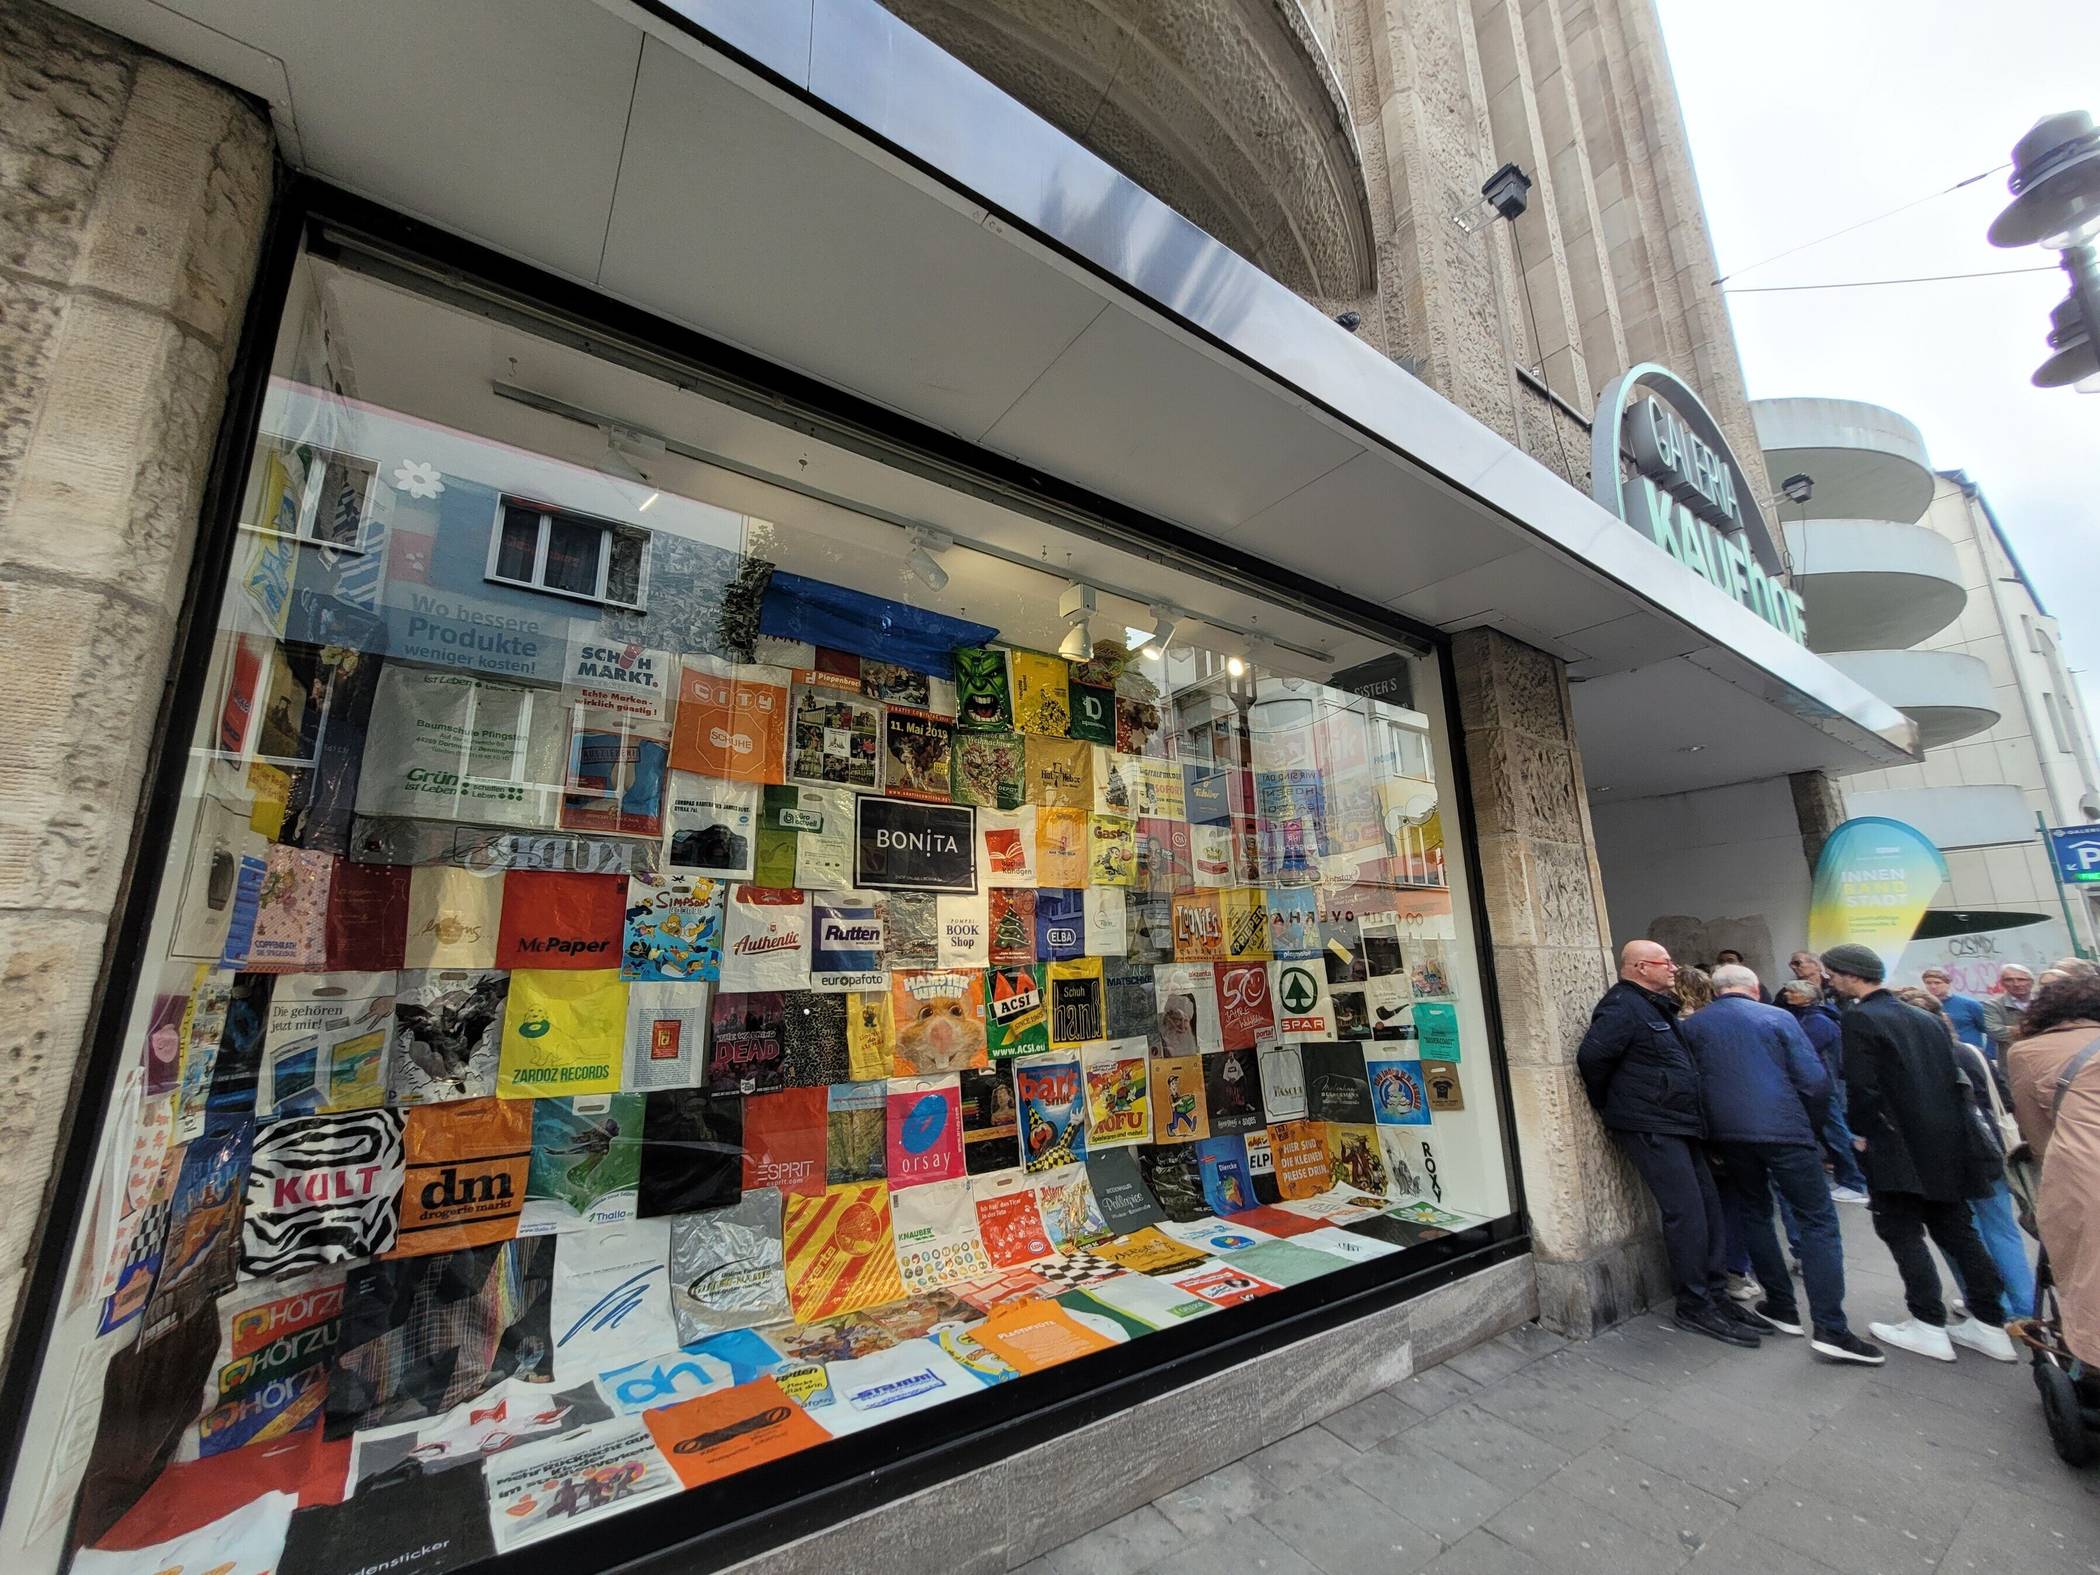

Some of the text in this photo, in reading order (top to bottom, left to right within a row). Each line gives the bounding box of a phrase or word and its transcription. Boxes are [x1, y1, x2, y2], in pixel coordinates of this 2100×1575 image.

[1648, 395, 1745, 530] GALERIA
[410, 593, 540, 634] Wo bessere
[407, 616, 539, 658] Produkte
[403, 644, 537, 675] weniger kosten!
[582, 689, 648, 706] Echte Marken
[693, 682, 773, 711] CITY
[617, 702, 652, 717] günstig
[416, 719, 480, 737] Baumschue
[890, 720, 948, 739] 11. Mai 2019
[711, 729, 753, 751] SCHUHE
[407, 767, 459, 787] Grün
[405, 782, 421, 792] ist
[421, 784, 457, 795] Leben
[998, 785, 1018, 793] DEPOT
[2077, 848, 2100, 870] P
[1841, 868, 1905, 883] INNEN
[825, 925, 880, 941] Rutten
[946, 925, 979, 936] BOOK
[1051, 932, 1073, 943] ELBA
[516, 937, 609, 957] McPaper
[732, 931, 801, 954] Authentic
[950, 935, 975, 949] Shop
[821, 974, 883, 988] europafoto
[1223, 967, 1266, 1010] 50
[1063, 985, 1086, 998] Schuh
[273, 1004, 343, 1018] Die gehören
[1001, 995, 1032, 1014] ACSI
[270, 1018, 324, 1034] jetzt mir!
[1014, 1016, 1030, 1031] SINCE
[1281, 1020, 1324, 1031] SPAR
[717, 1032, 737, 1041] THE
[1255, 1028, 1274, 1040] porta!
[716, 1039, 780, 1063] DEAD
[992, 1043, 1046, 1057] www.ACSI.eu
[512, 1064, 610, 1084] ZARDOZ RECORDS
[1018, 1068, 1079, 1101] bart
[1283, 1138, 1317, 1153] HIER SIND
[902, 1152, 951, 1173] orsay
[1218, 1162, 1238, 1172] Diercke
[1281, 1150, 1323, 1168] DIE KLEINEN
[757, 1160, 815, 1181] ESPRIT
[1283, 1164, 1330, 1182] PREISE DRIN.
[1421, 1142, 1442, 1203] ROXY
[274, 1164, 383, 1207] KULT
[421, 1168, 514, 1210] dm
[767, 1177, 803, 1187] esprit.com
[419, 1199, 512, 1221] drogerie markt
[898, 1227, 932, 1241] KNAUBER
[499, 1486, 522, 1499] im
[348, 1539, 450, 1575] densticker
